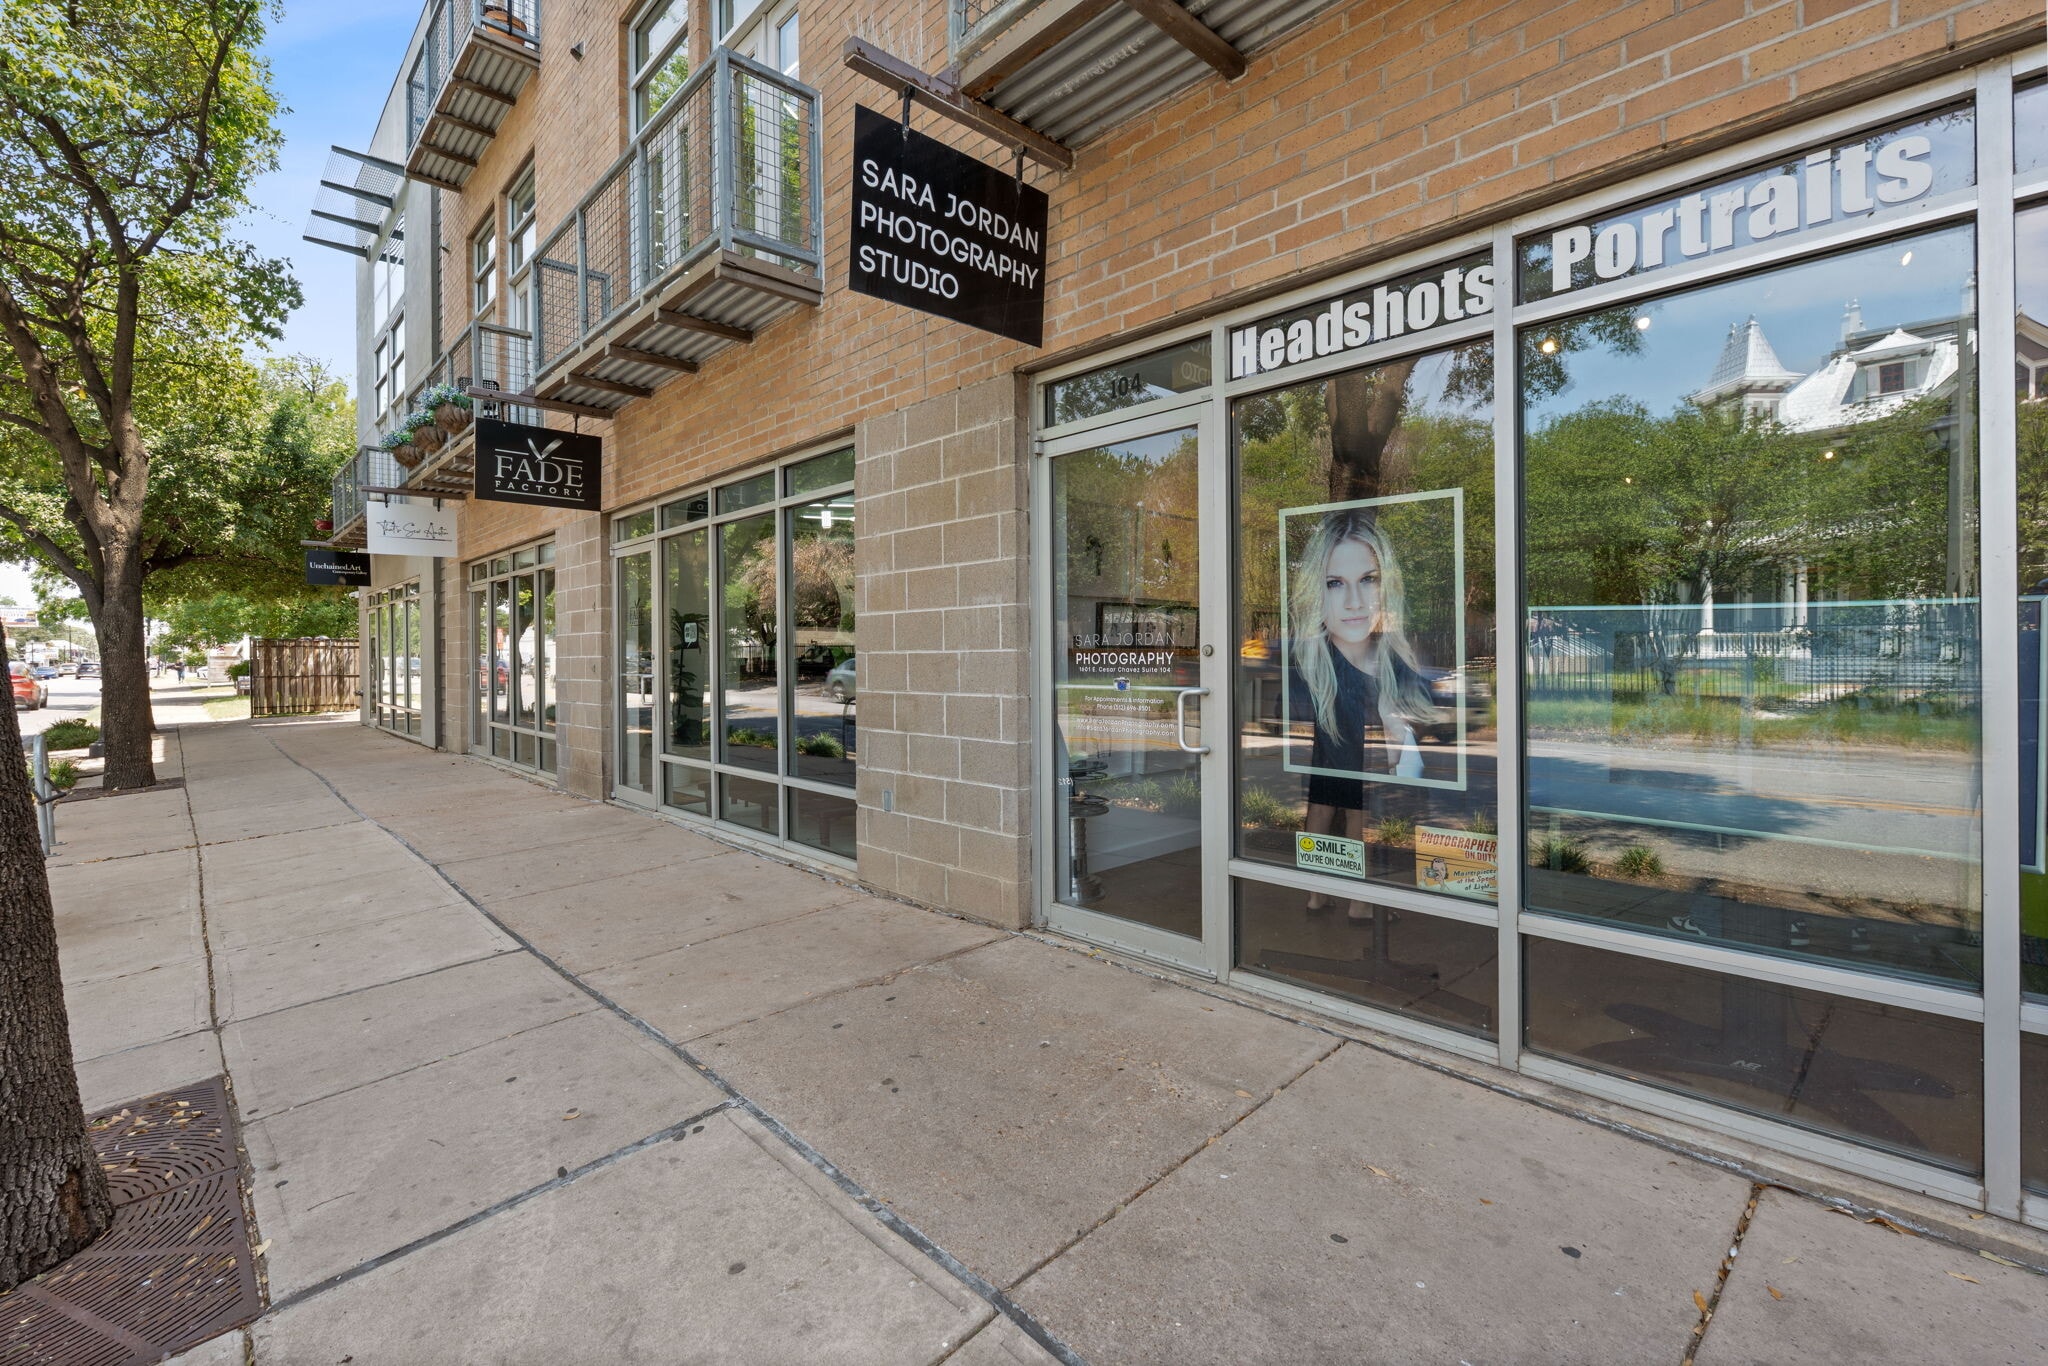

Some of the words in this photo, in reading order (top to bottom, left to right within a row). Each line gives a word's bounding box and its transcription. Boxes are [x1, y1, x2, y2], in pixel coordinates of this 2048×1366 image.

[862, 158, 936, 213] SARA
[945, 193, 1039, 255] JORDAN
[1551, 135, 1933, 292] Portraits
[860, 200, 1039, 290] PHOTOGRAPHY
[859, 245, 959, 299] STUDIO
[1231, 262, 1495, 380] Headshots
[1110, 372, 1142, 400] 104
[494, 454, 584, 488] FADE
[494, 480, 583, 497] FACTORY
[1075, 633, 1110, 647] SARA
[1115, 631, 1175, 646] JORDAN
[1076, 651, 1174, 665] PHOTOGRAPHY
[1315, 840, 1347, 856] SMILE
[1420, 832, 1497, 853] PHOTOGRAPHER
[1300, 853, 1324, 865] YOU'RE
[1325, 856, 1335, 867] ON
[1335, 858, 1362, 872] CAMERA
[1464, 851, 1476, 860] ON
[1477, 852, 1497, 862] DUTY
